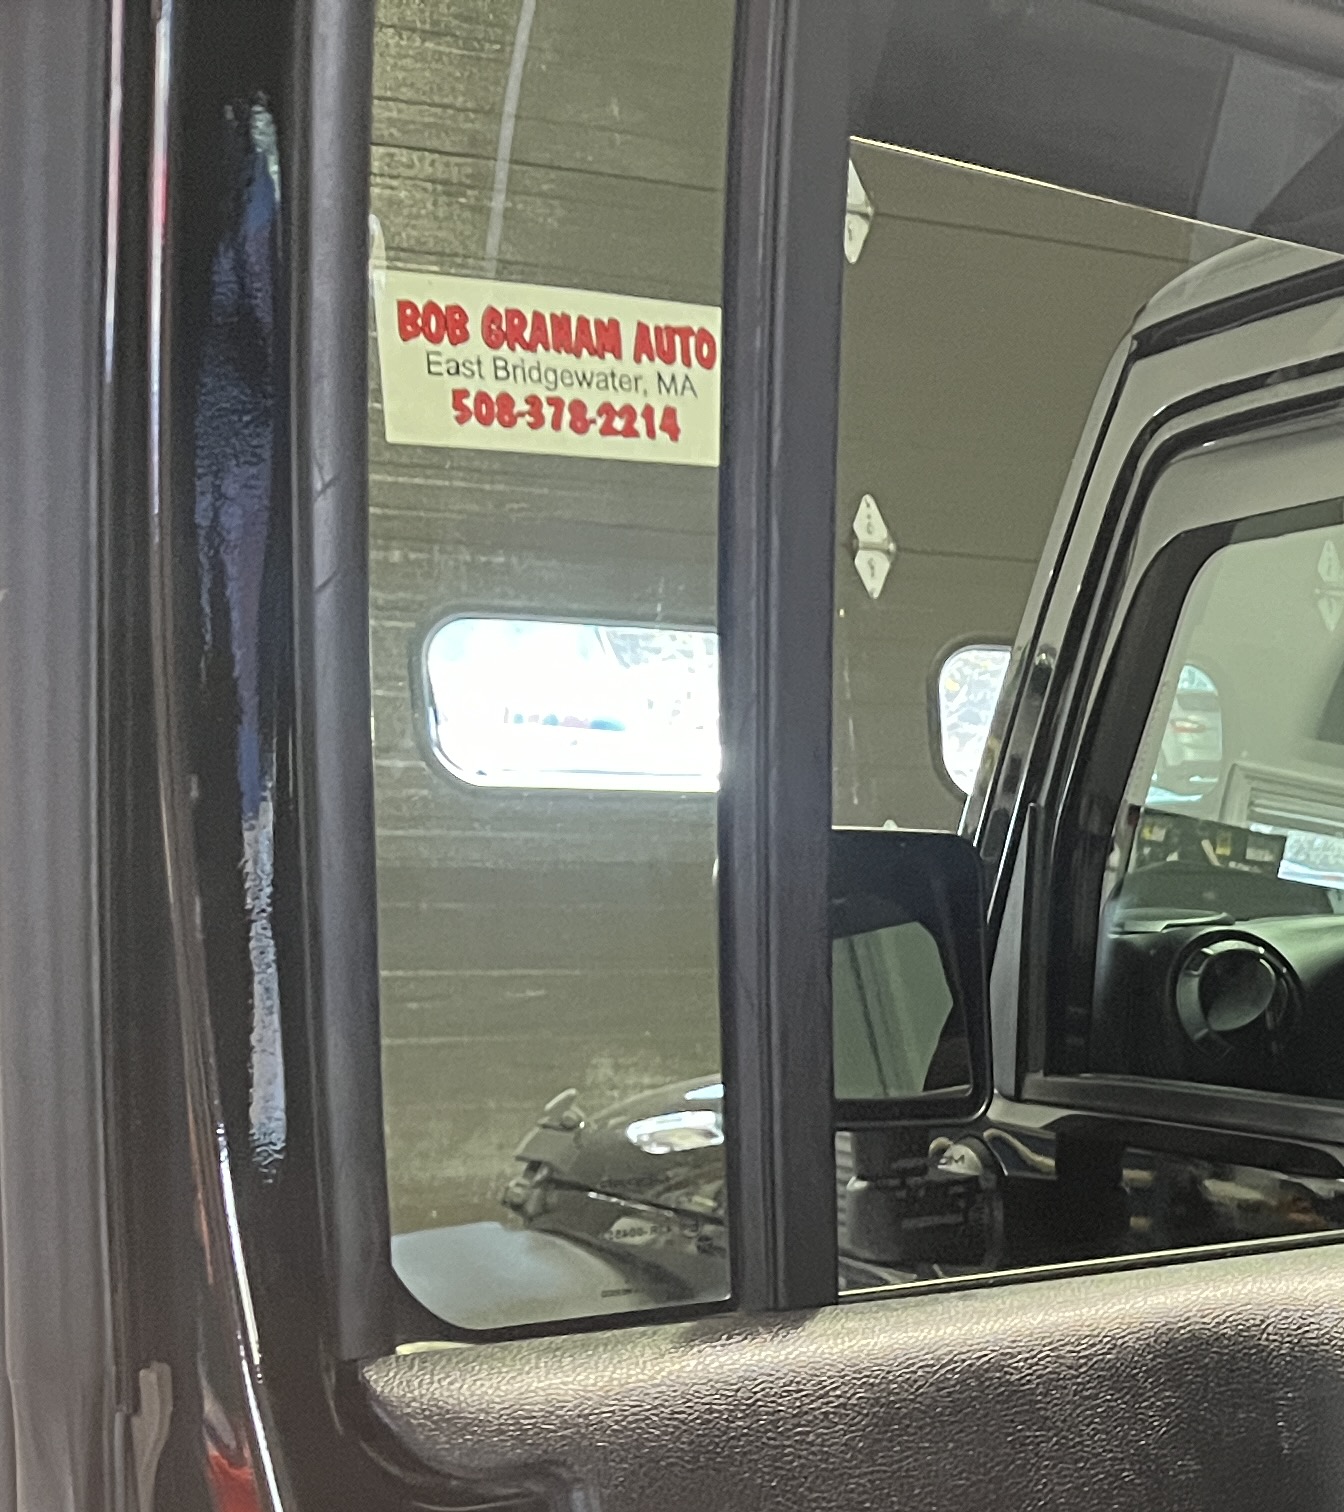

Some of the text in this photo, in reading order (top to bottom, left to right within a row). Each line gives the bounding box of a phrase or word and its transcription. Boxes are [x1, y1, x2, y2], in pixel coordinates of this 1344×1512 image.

[396, 298, 717, 370] BOB GRAHAM AUTO
[425, 350, 699, 398] East Bridgewater, MA
[451, 388, 681, 442] 508-378-2214
